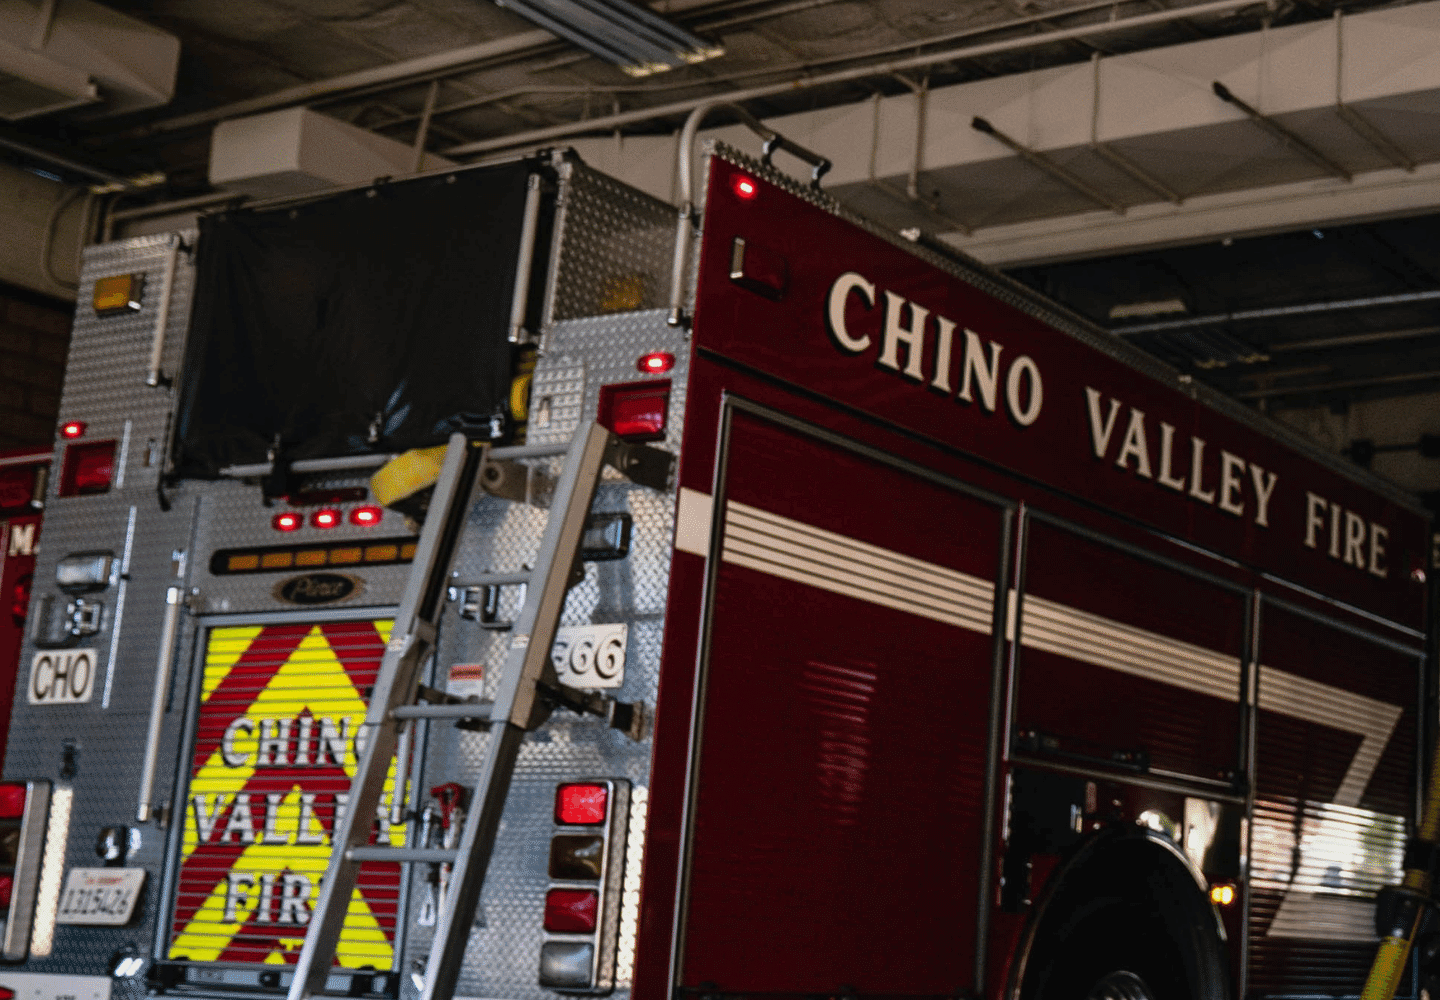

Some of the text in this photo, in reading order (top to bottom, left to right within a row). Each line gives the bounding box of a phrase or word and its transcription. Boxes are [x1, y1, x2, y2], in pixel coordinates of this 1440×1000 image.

[826, 272, 1389, 578] CHINO VALLEY FIRE
[33, 654, 91, 700] CHO
[221, 872, 319, 925] FIR
